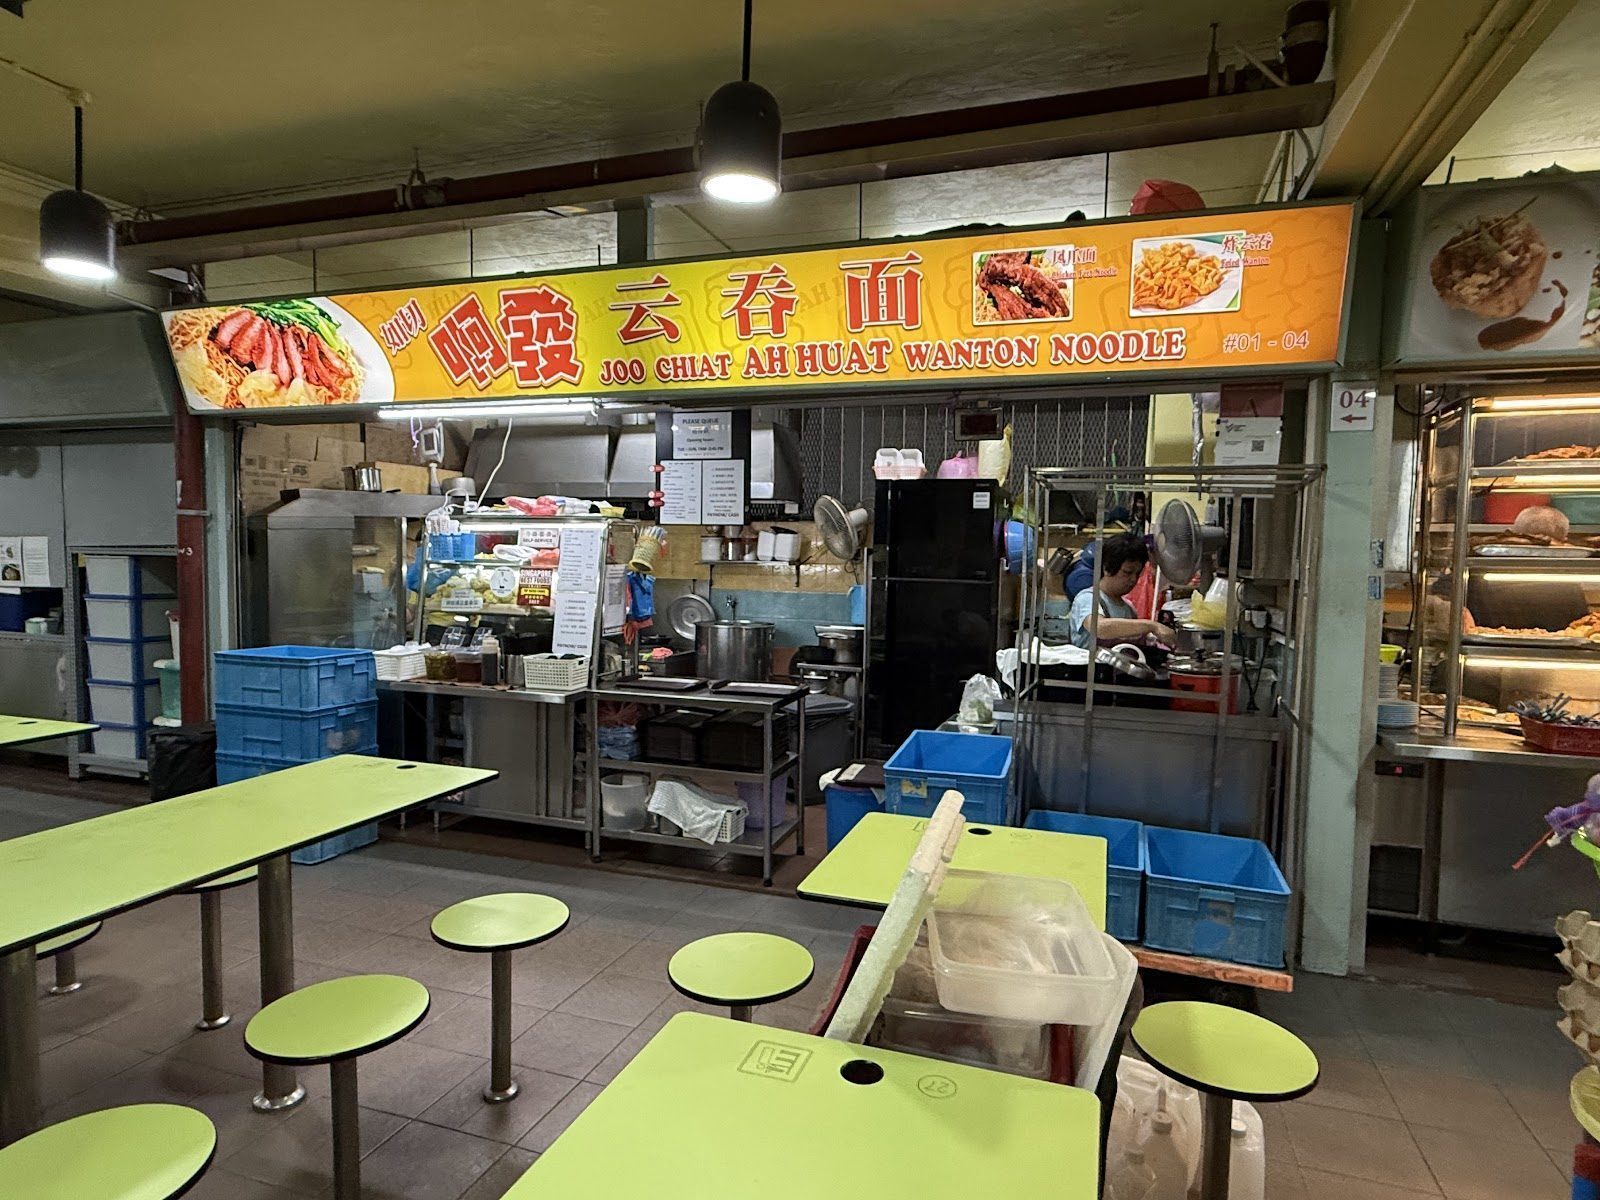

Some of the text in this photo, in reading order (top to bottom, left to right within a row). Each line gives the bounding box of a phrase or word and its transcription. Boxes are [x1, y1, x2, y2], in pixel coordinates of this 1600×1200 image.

[608, 250, 924, 345] 云吞面
[1223, 332, 1261, 354] #01
[1282, 329, 1310, 351] 04
[599, 327, 1186, 384] JOO CHIAT AH HUAT WANTON NOODLE
[1339, 390, 1370, 409] 04
[520, 569, 553, 577] SINGAPORE
